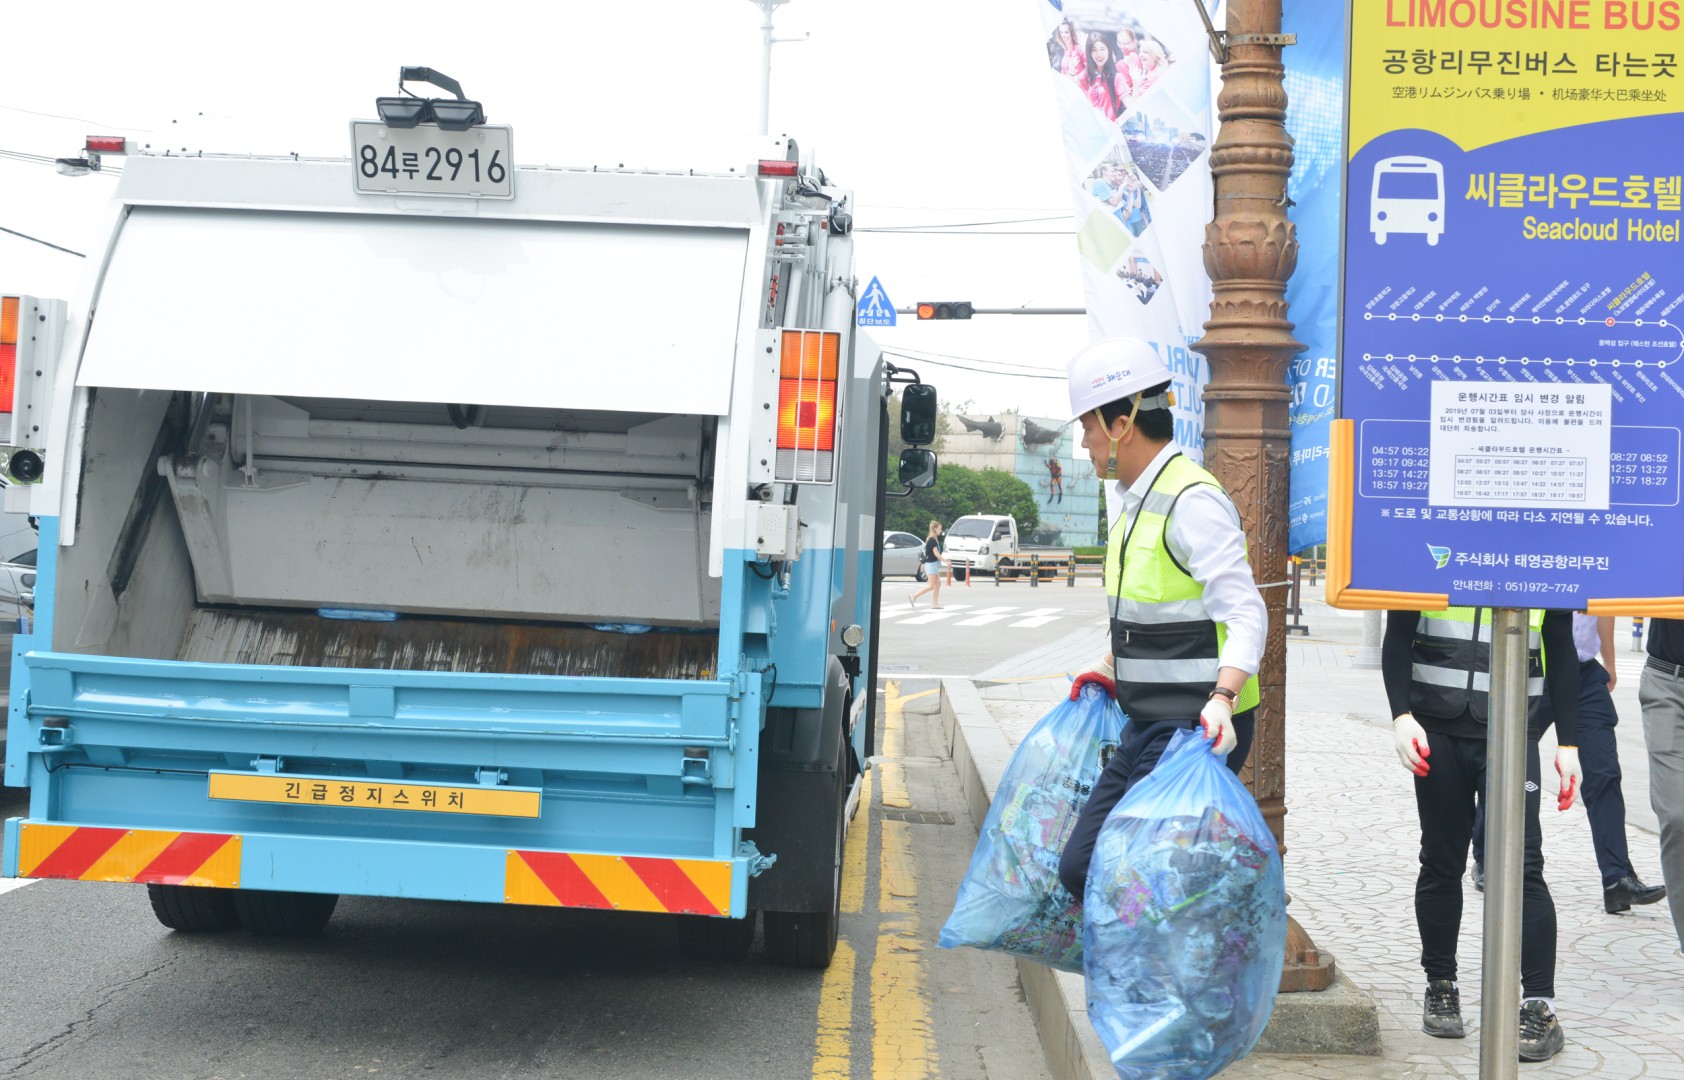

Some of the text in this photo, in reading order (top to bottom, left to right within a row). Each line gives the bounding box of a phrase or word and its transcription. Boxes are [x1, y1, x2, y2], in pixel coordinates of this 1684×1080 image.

[1386, 0, 1681, 30] LIMOUSINE BUS
[1382, 49, 1678, 78] 공항리무진버스 타는곳
[1392, 86, 1530, 100] 空港リムジンバス乗り場
[1465, 172, 1682, 211] 씨클라우드호텔
[1522, 216, 1680, 242] Seacloud Hotel
[1458, 392, 1586, 404] 운행시간표 임시 변경 알림
[1372, 446, 1428, 456] 04:57 05:22
[1610, 453, 1668, 462] 08:27 08:52
[1372, 458, 1428, 467] 09:17 09:42
[1610, 464, 1668, 474] 12:57 13:27
[1372, 470, 1428, 478] 13:57 14:27
[1372, 481, 1428, 490] 18:57 19:27
[1610, 476, 1668, 486] 17:57 18:27
[1394, 508, 1416, 519] 도로
[1421, 508, 1432, 520] 및
[1436, 508, 1492, 522] 교통상황에
[1496, 510, 1520, 522] 따라
[1524, 511, 1546, 523] 다소
[1550, 512, 1584, 524] 지연될
[1588, 513, 1600, 524] 수
[1604, 514, 1654, 526] 있습니다.
[1454, 552, 1609, 570] 주식회사 태영공항리무진
[1453, 580, 1493, 590] 안내전화
[1505, 581, 1580, 593] 051)972-7747
[284, 782, 465, 808] 긴급정지스위치
